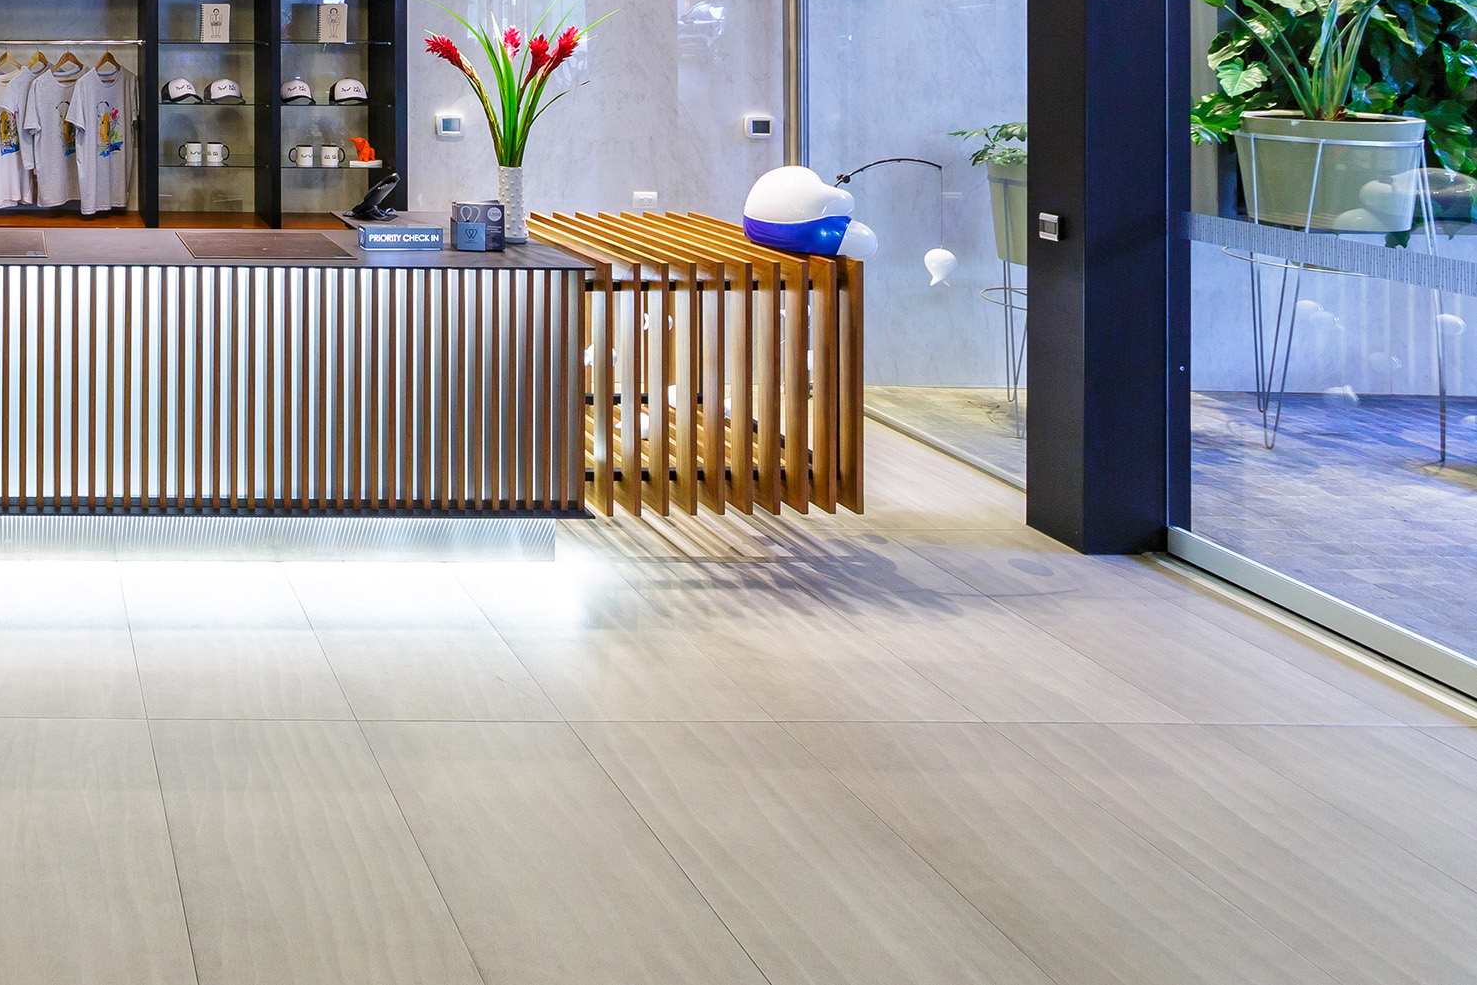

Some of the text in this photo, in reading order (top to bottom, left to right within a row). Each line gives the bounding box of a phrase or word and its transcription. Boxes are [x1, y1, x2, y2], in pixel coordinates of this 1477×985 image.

[368, 234, 440, 242] PRIORITY CHECK IN
